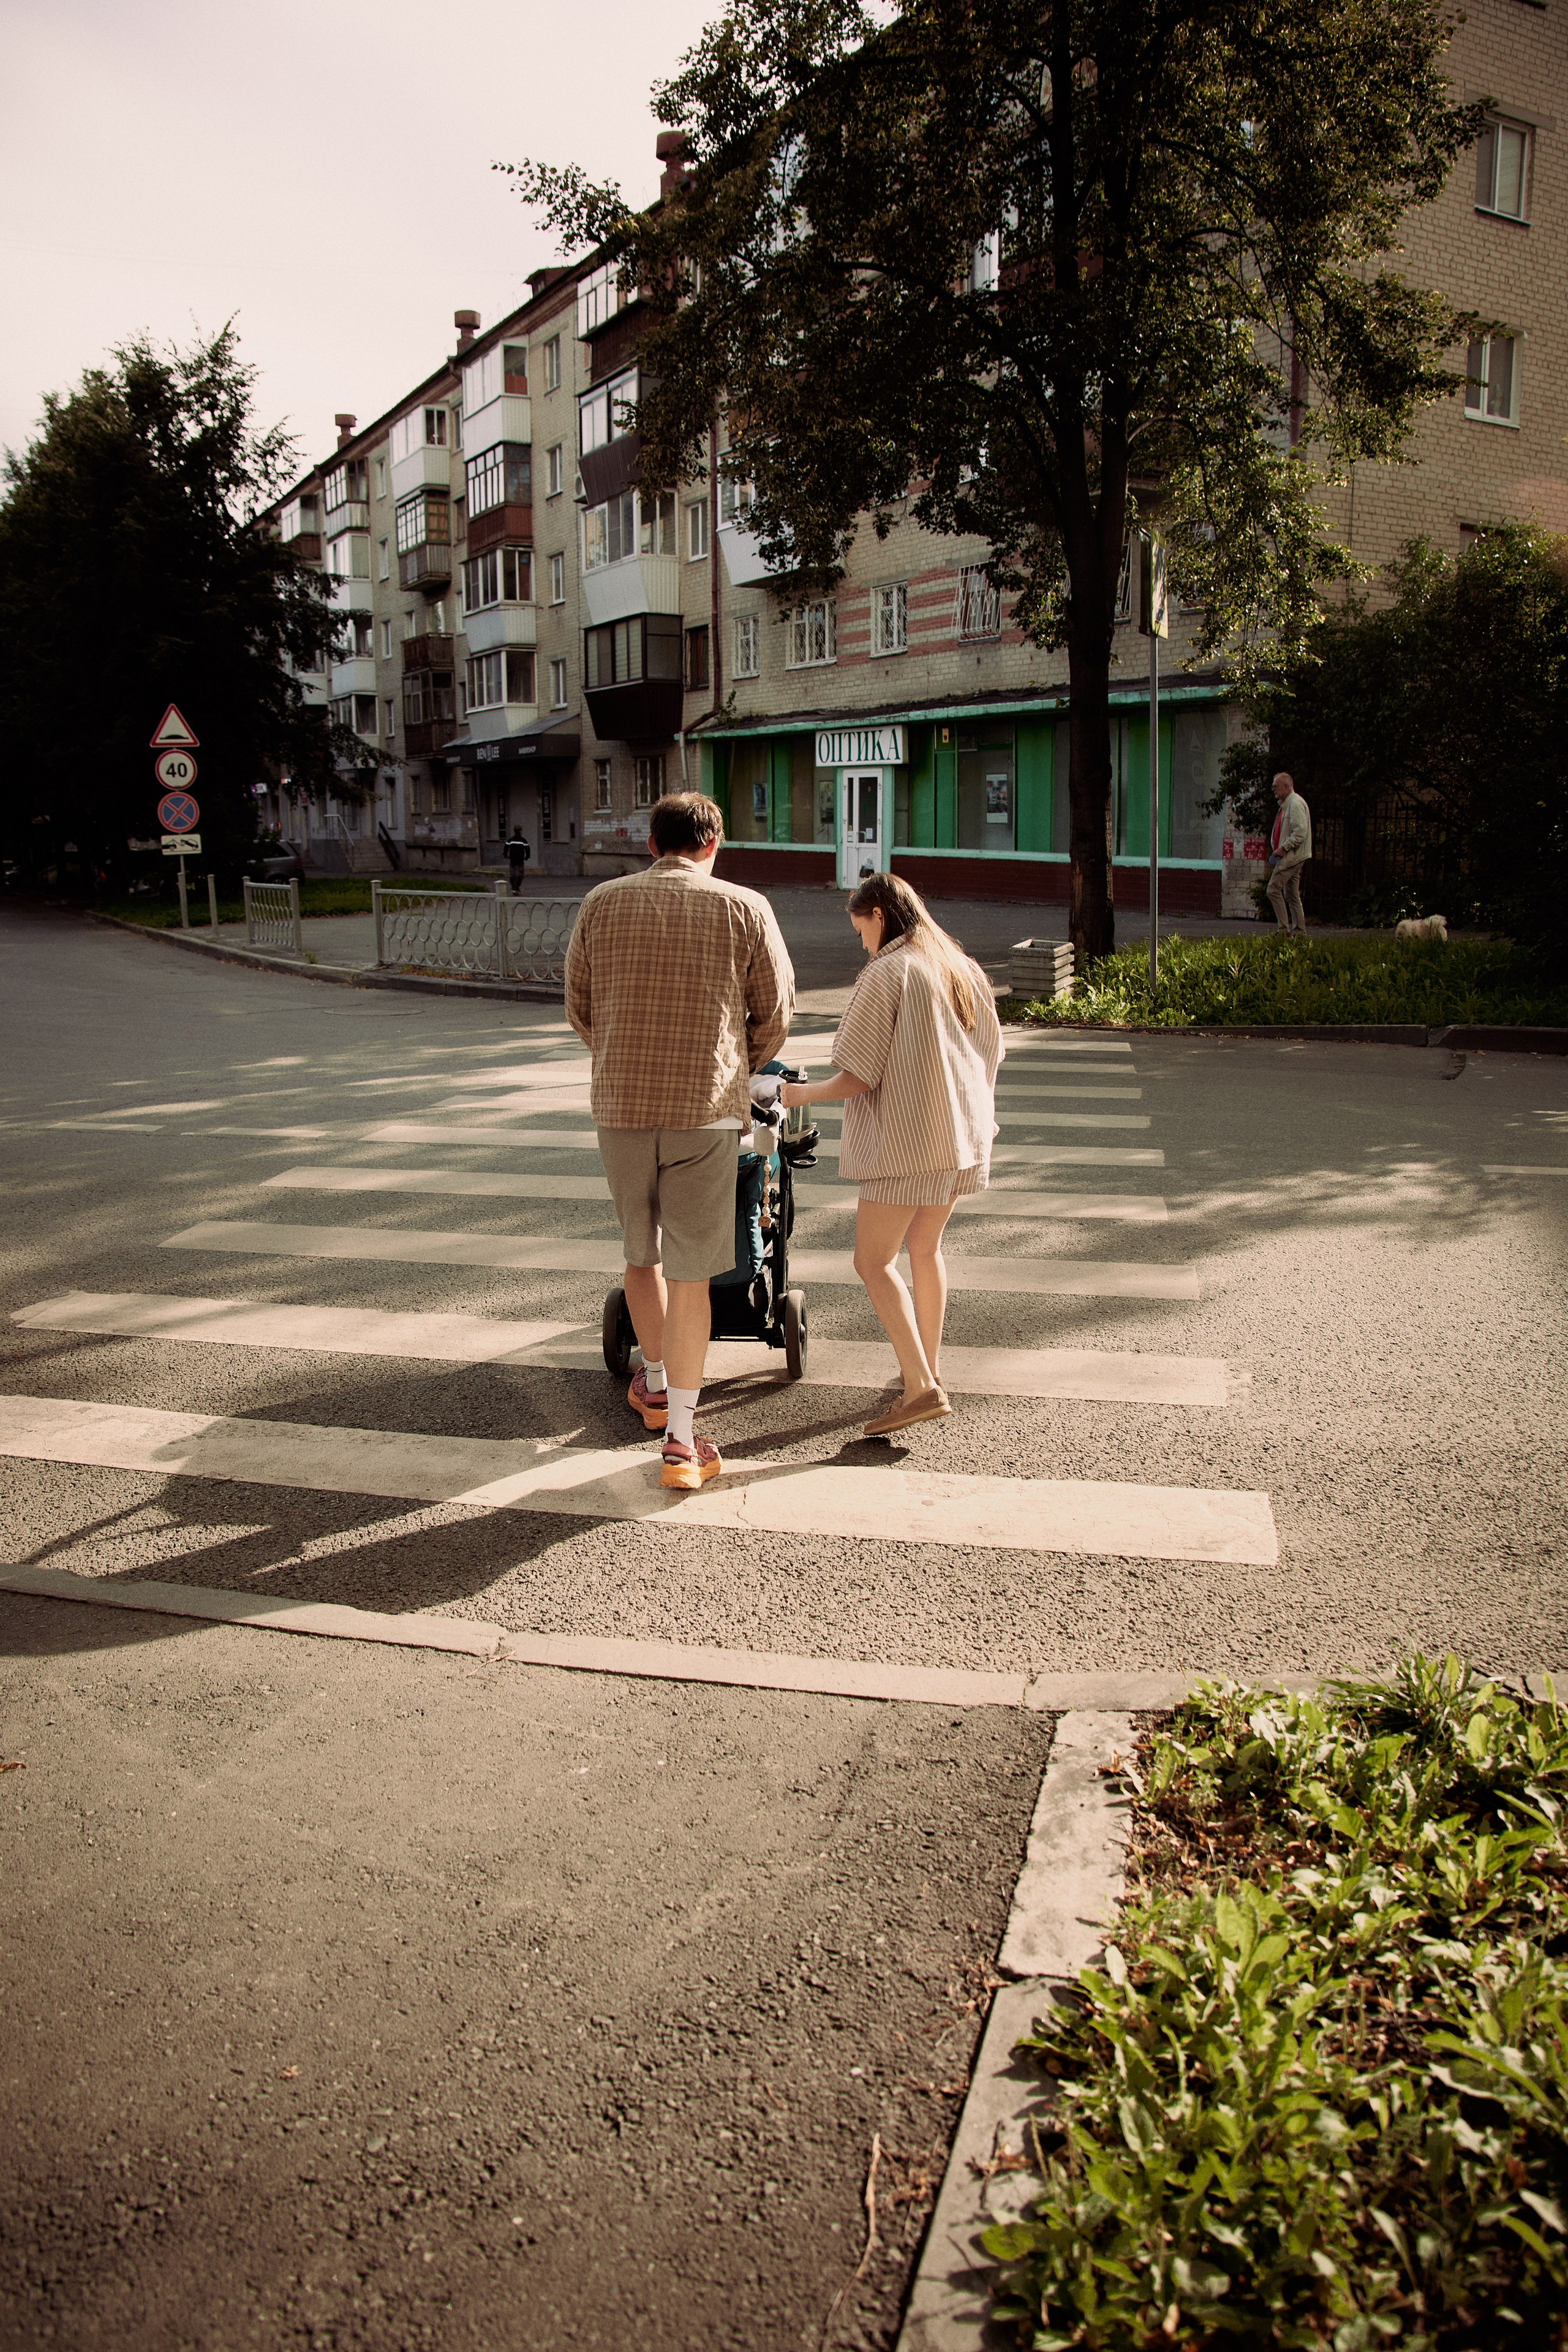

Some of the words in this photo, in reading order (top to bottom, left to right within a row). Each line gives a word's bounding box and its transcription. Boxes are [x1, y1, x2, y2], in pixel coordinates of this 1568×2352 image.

[491, 746, 500, 758] LEE
[818, 728, 901, 764] ОПТИКА
[166, 763, 187, 778] 40
